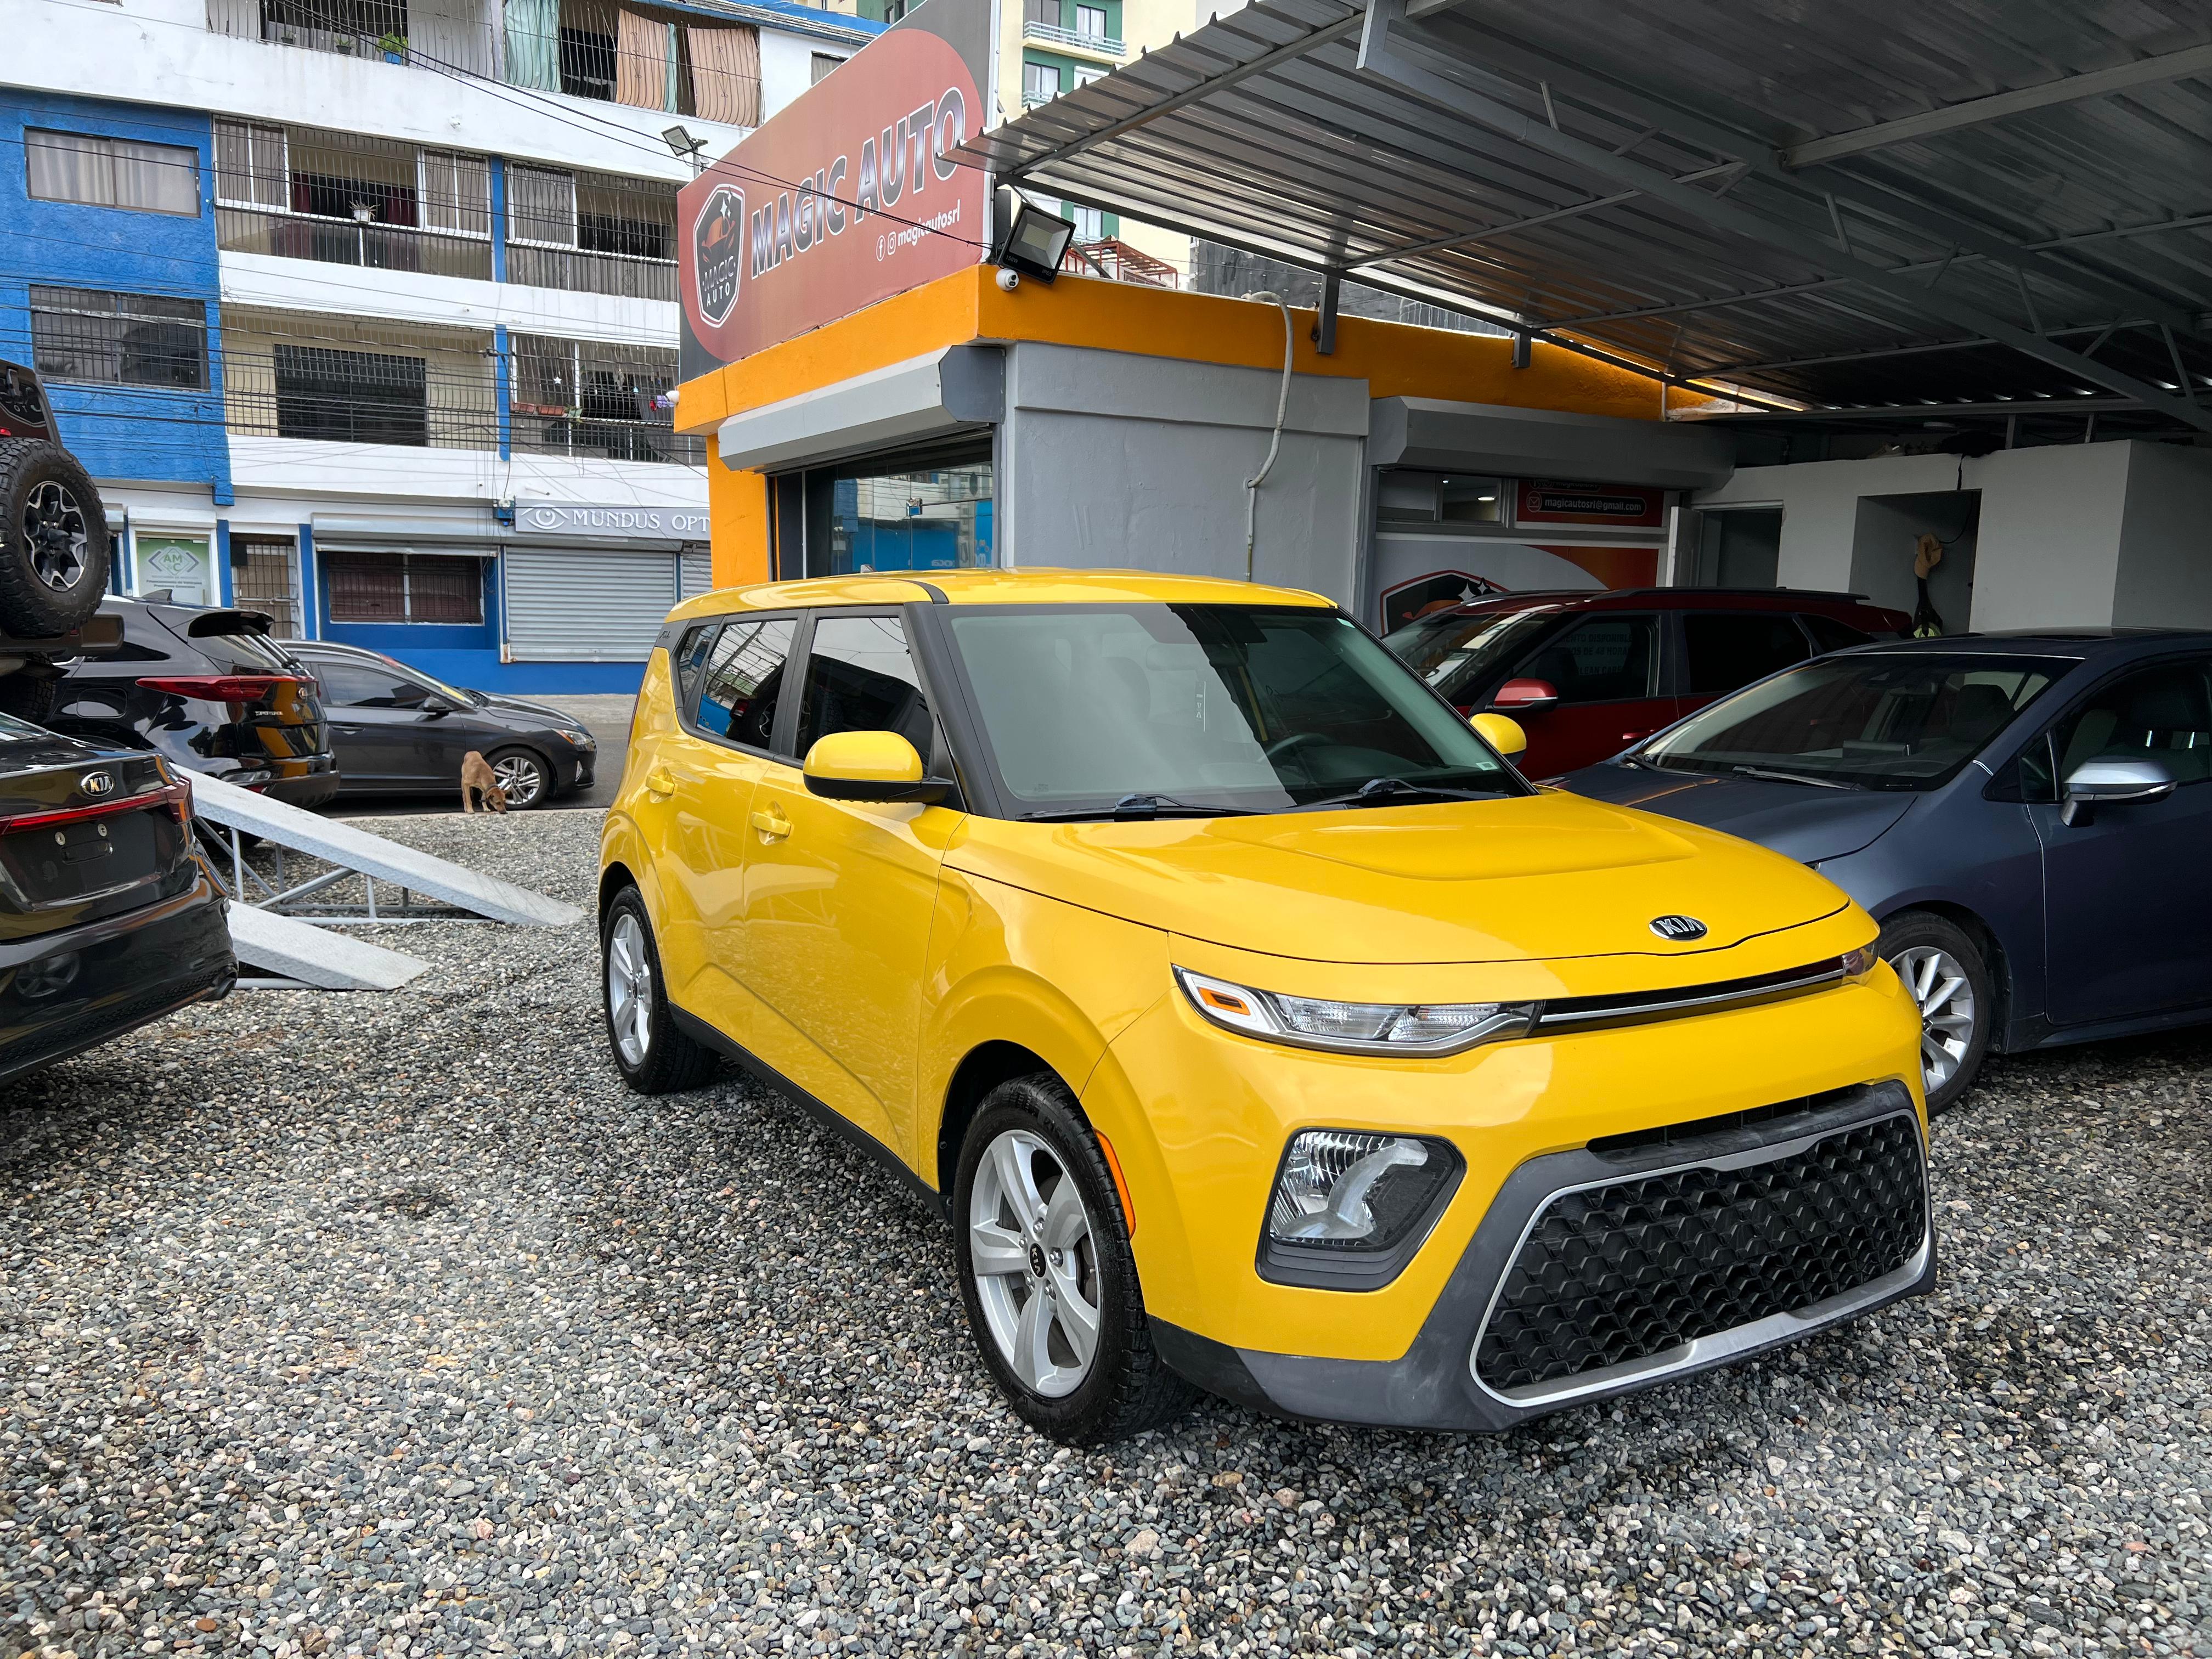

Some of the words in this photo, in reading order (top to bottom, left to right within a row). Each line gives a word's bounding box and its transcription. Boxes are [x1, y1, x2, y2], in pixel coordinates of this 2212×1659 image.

[752, 155, 847, 280] MAGIC
[854, 86, 966, 224] AUTO
[898, 199, 961, 246] magicautosrl
[706, 282, 730, 307] AUTO
[1544, 498, 1641, 511] magicautosrl@gmail.com
[572, 509, 661, 529] MUNDUS
[88, 776, 111, 793] KIA
[1656, 917, 1704, 935] KIA
[1031, 1247, 1041, 1274] KIA
